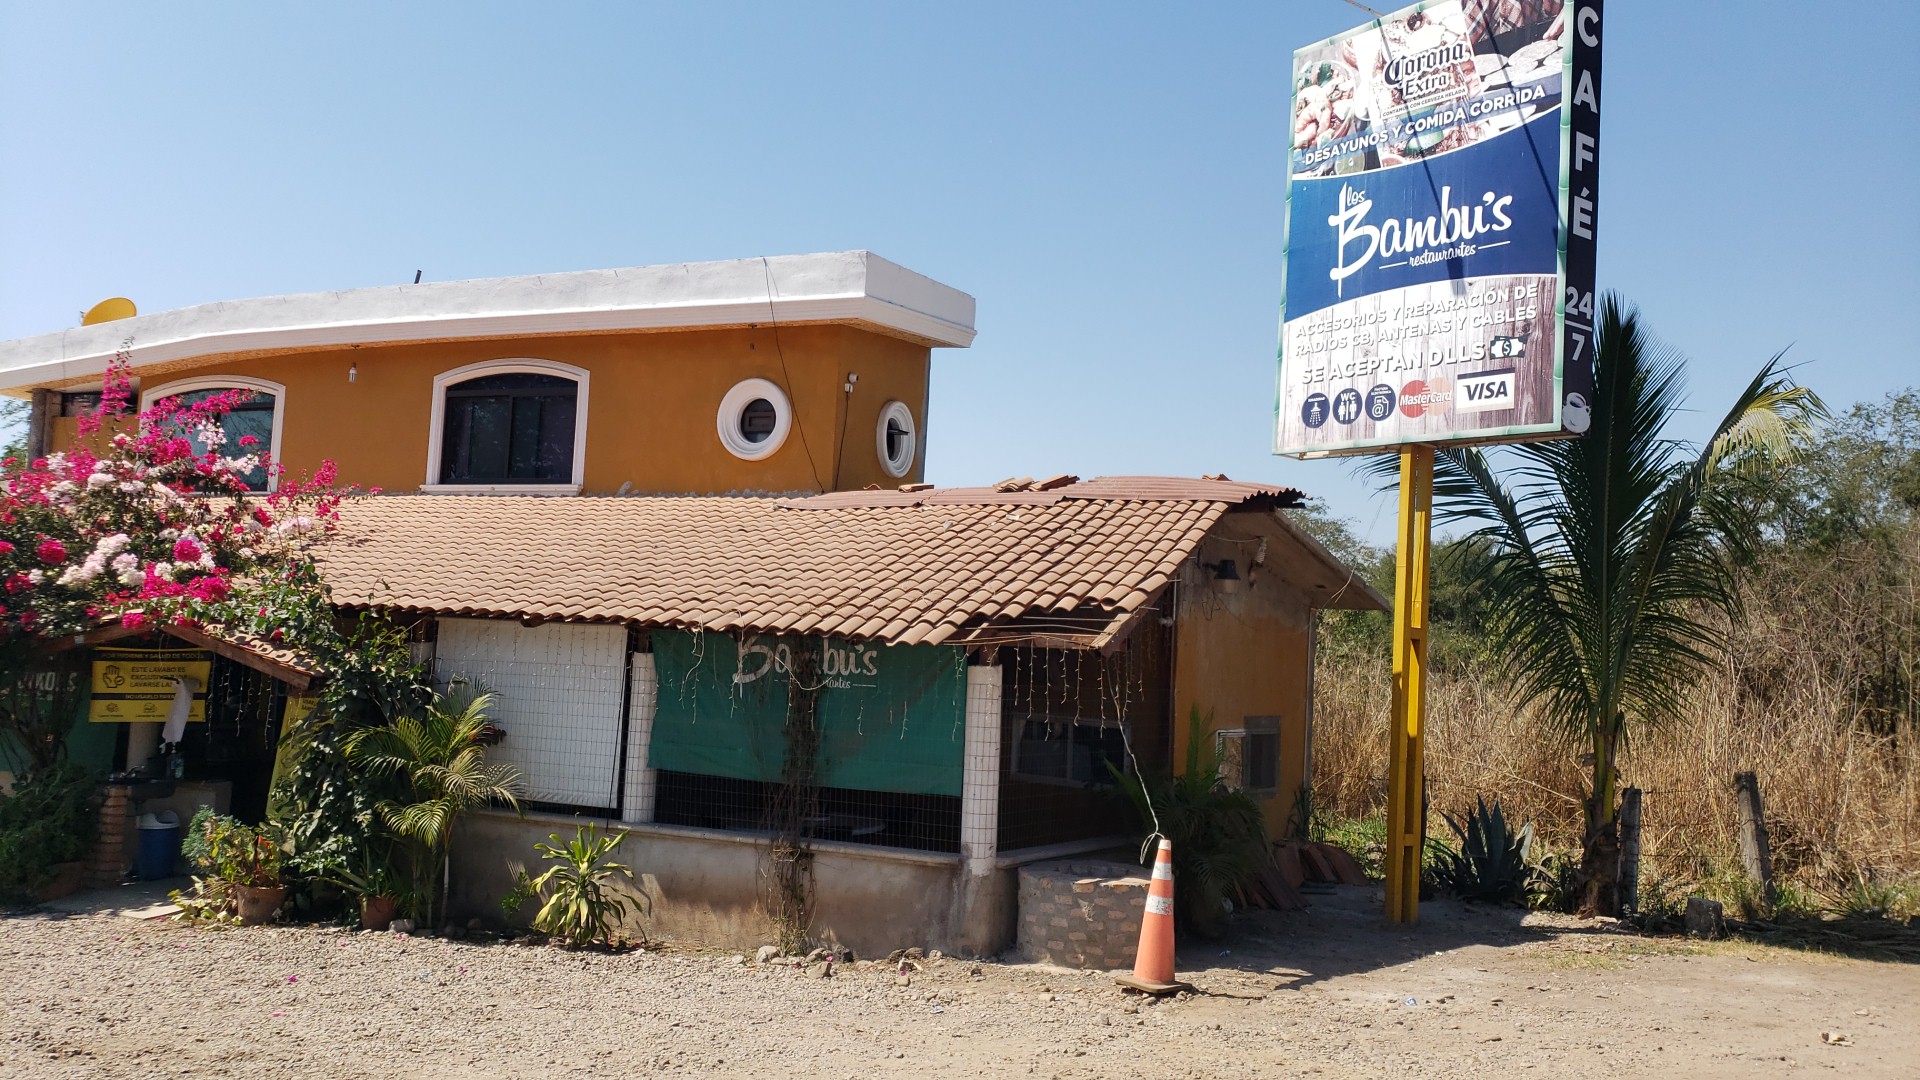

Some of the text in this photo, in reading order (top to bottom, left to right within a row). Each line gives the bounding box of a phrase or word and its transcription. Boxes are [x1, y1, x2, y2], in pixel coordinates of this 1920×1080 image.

[1384, 42, 1465, 86] Corona
[1382, 88, 1466, 117] CONTAMOS CON CERVEZA HELADA
[1405, 74, 1448, 97] Extra
[1305, 85, 1546, 166] DESAYUNOS Y COMIDA CORRIDA
[1573, 6, 1600, 240] CAFÉ
[1346, 186, 1366, 206] los
[1328, 181, 1513, 298] Bambu's
[1409, 241, 1477, 267] restaurantes
[1296, 284, 1539, 338] ACCESORIOS Y REPARACIÓN DE
[1565, 286, 1594, 320] 24
[1296, 305, 1538, 357] RADIOS CB, ANTENAS Y CABLES
[1571, 332, 1586, 361] 7
[1301, 342, 1486, 384] SE ACEPTAN DLLS
[1340, 391, 1356, 402] WC
[1400, 390, 1453, 406] MasterCard
[1462, 380, 1508, 401] VISA
[732, 634, 878, 699] Babu's
